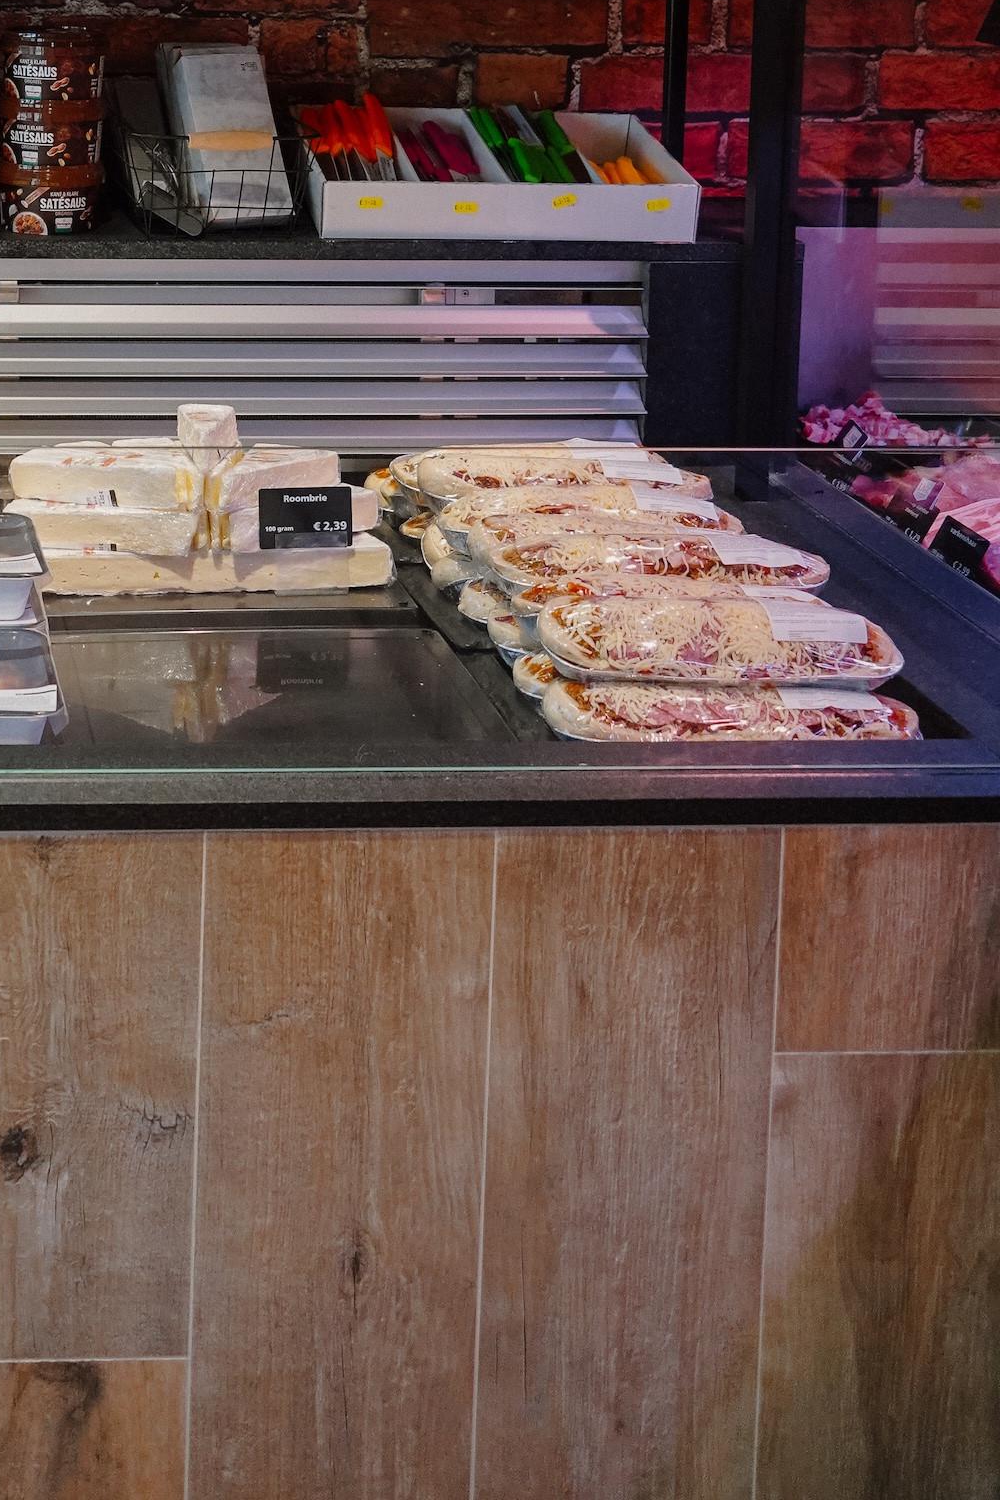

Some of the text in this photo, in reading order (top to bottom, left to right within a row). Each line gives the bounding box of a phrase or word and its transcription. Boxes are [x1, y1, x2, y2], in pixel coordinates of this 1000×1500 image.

[13, 64, 58, 77] SATÉSAUS
[10, 130, 55, 143] SATÉSAUS
[40, 197, 86, 209] SATÉSAUS
[283, 493, 328, 503] Roombrie
[313, 521, 321, 531] €
[322, 521, 347, 532] 2,39
